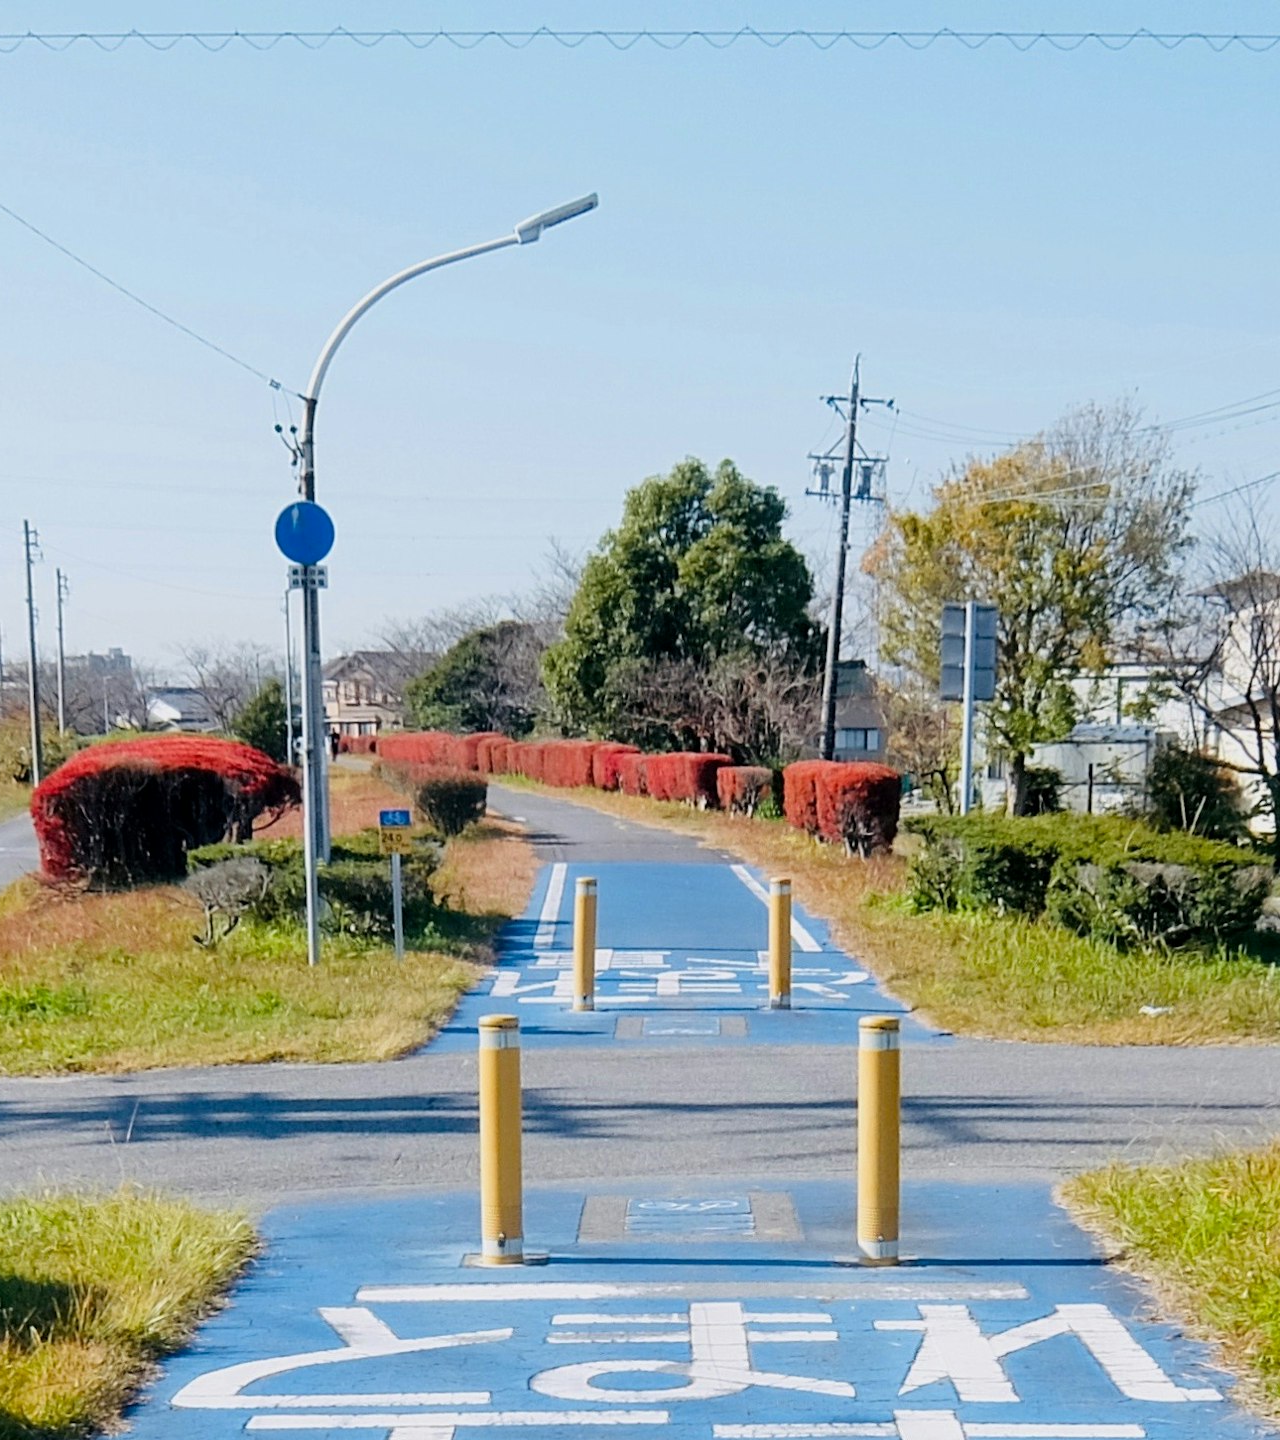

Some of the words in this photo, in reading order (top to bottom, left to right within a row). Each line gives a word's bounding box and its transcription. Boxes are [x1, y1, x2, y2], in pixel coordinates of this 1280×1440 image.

[486, 968, 871, 999] とまれ
[171, 1302, 1224, 1406] とまれ
